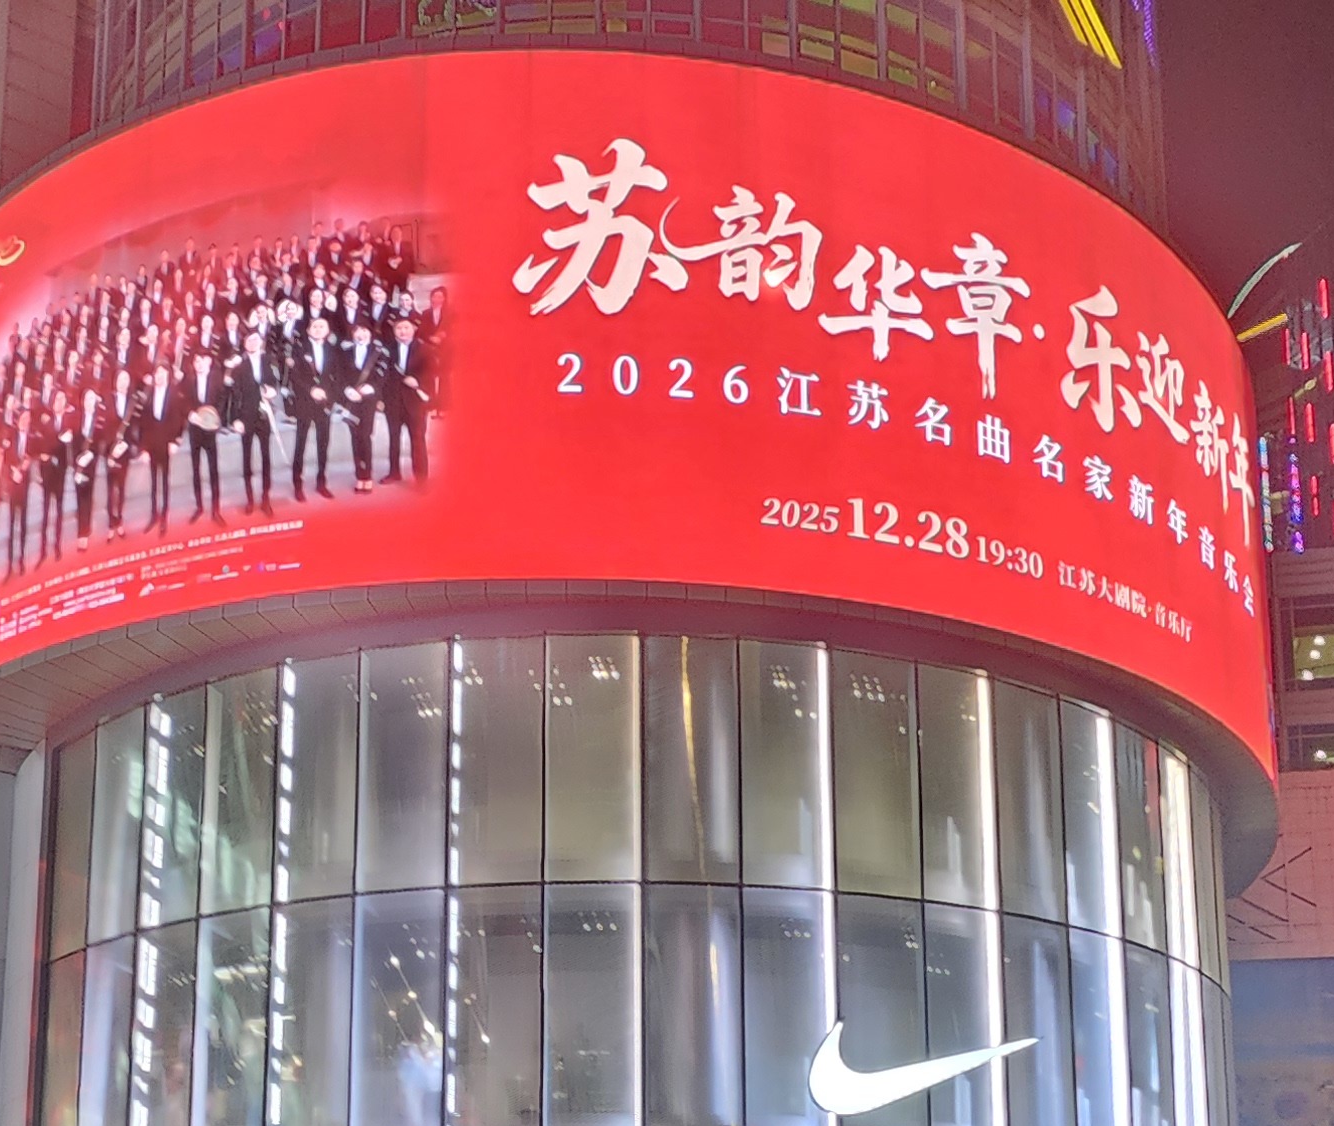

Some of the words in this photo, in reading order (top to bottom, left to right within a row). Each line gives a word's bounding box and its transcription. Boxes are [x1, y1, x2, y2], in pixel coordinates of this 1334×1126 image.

[760, 497, 840, 533] 2025
[846, 497, 970, 558] 12.28
[975, 535, 1045, 579] 19:30
